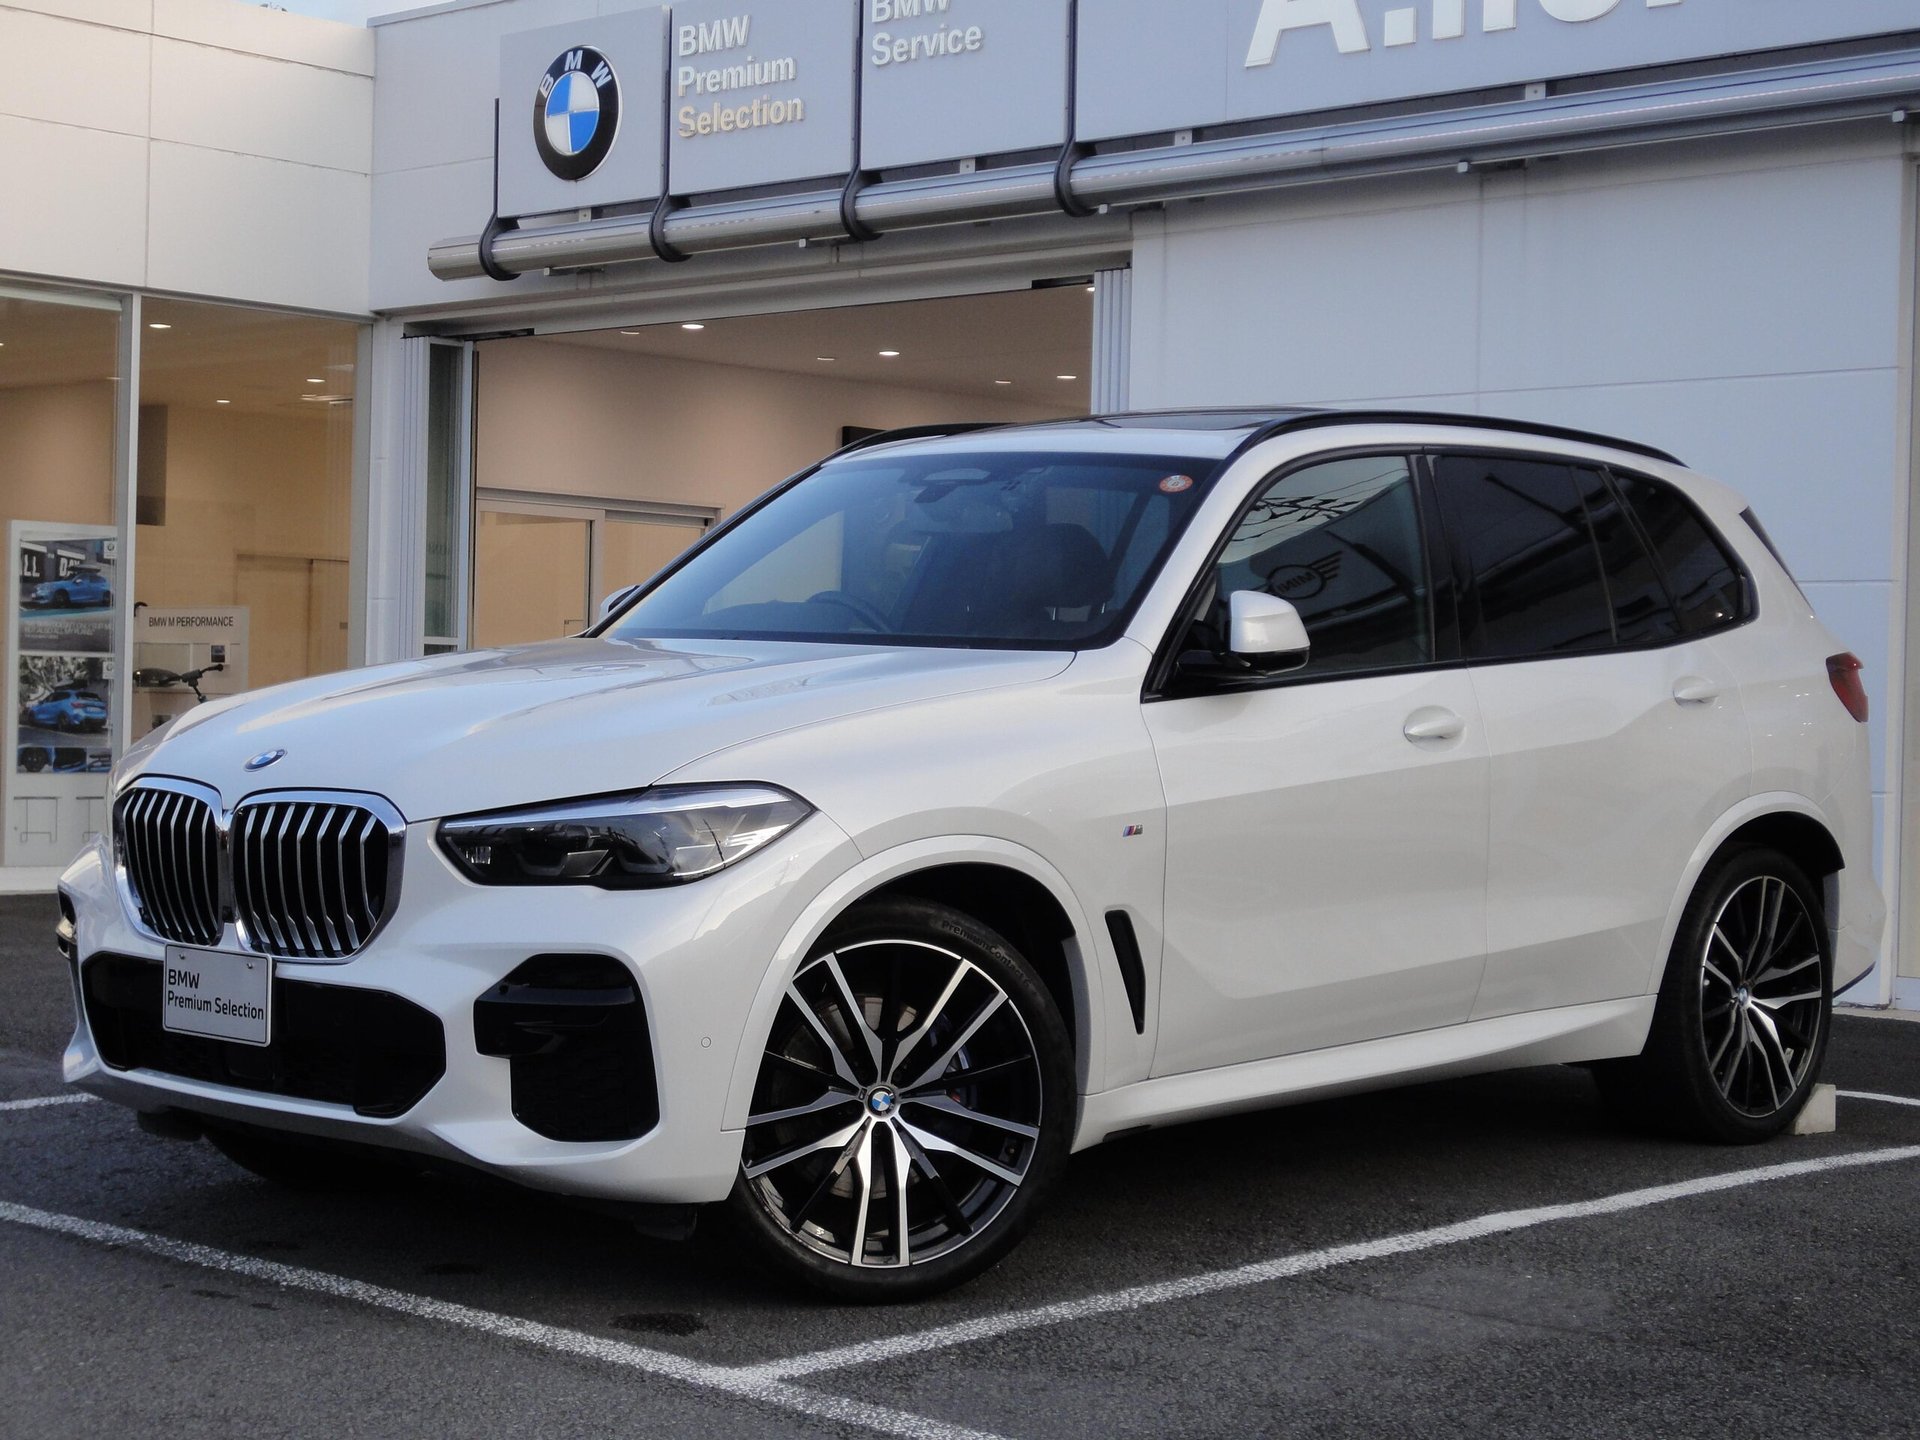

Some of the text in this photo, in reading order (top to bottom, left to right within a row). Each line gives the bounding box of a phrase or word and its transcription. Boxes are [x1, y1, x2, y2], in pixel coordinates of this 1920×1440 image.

[679, 14, 750, 56] BMW
[872, 24, 982, 66] Service
[539, 50, 612, 98] BMW
[678, 56, 796, 97] Premium
[678, 94, 805, 138] Selection
[149, 616, 234, 627] BMW M PERFORMANCE
[168, 968, 200, 989] BMW
[167, 990, 264, 1020] Premium Selection
